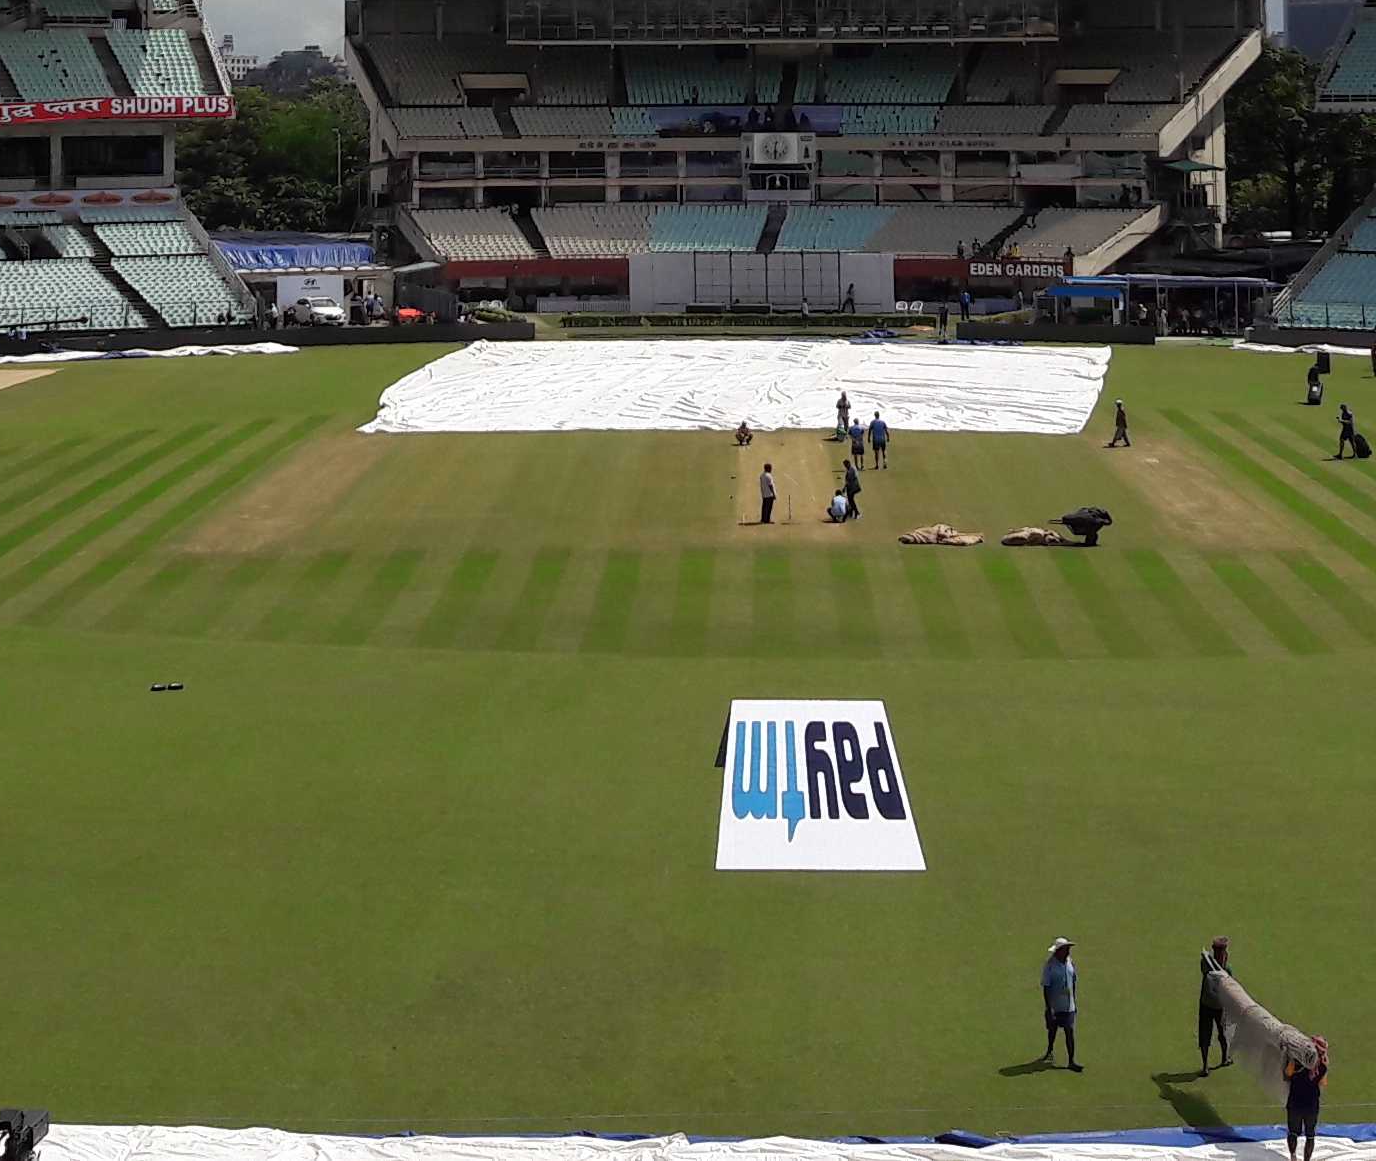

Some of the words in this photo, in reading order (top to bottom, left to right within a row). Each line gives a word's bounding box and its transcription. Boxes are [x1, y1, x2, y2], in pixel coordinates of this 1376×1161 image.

[43, 99, 105, 115] प्लस
[111, 98, 175, 115] SHUDH
[182, 97, 231, 113] PLUS
[970, 262, 1002, 276] EDEN
[1006, 263, 1064, 277] GARDENS
